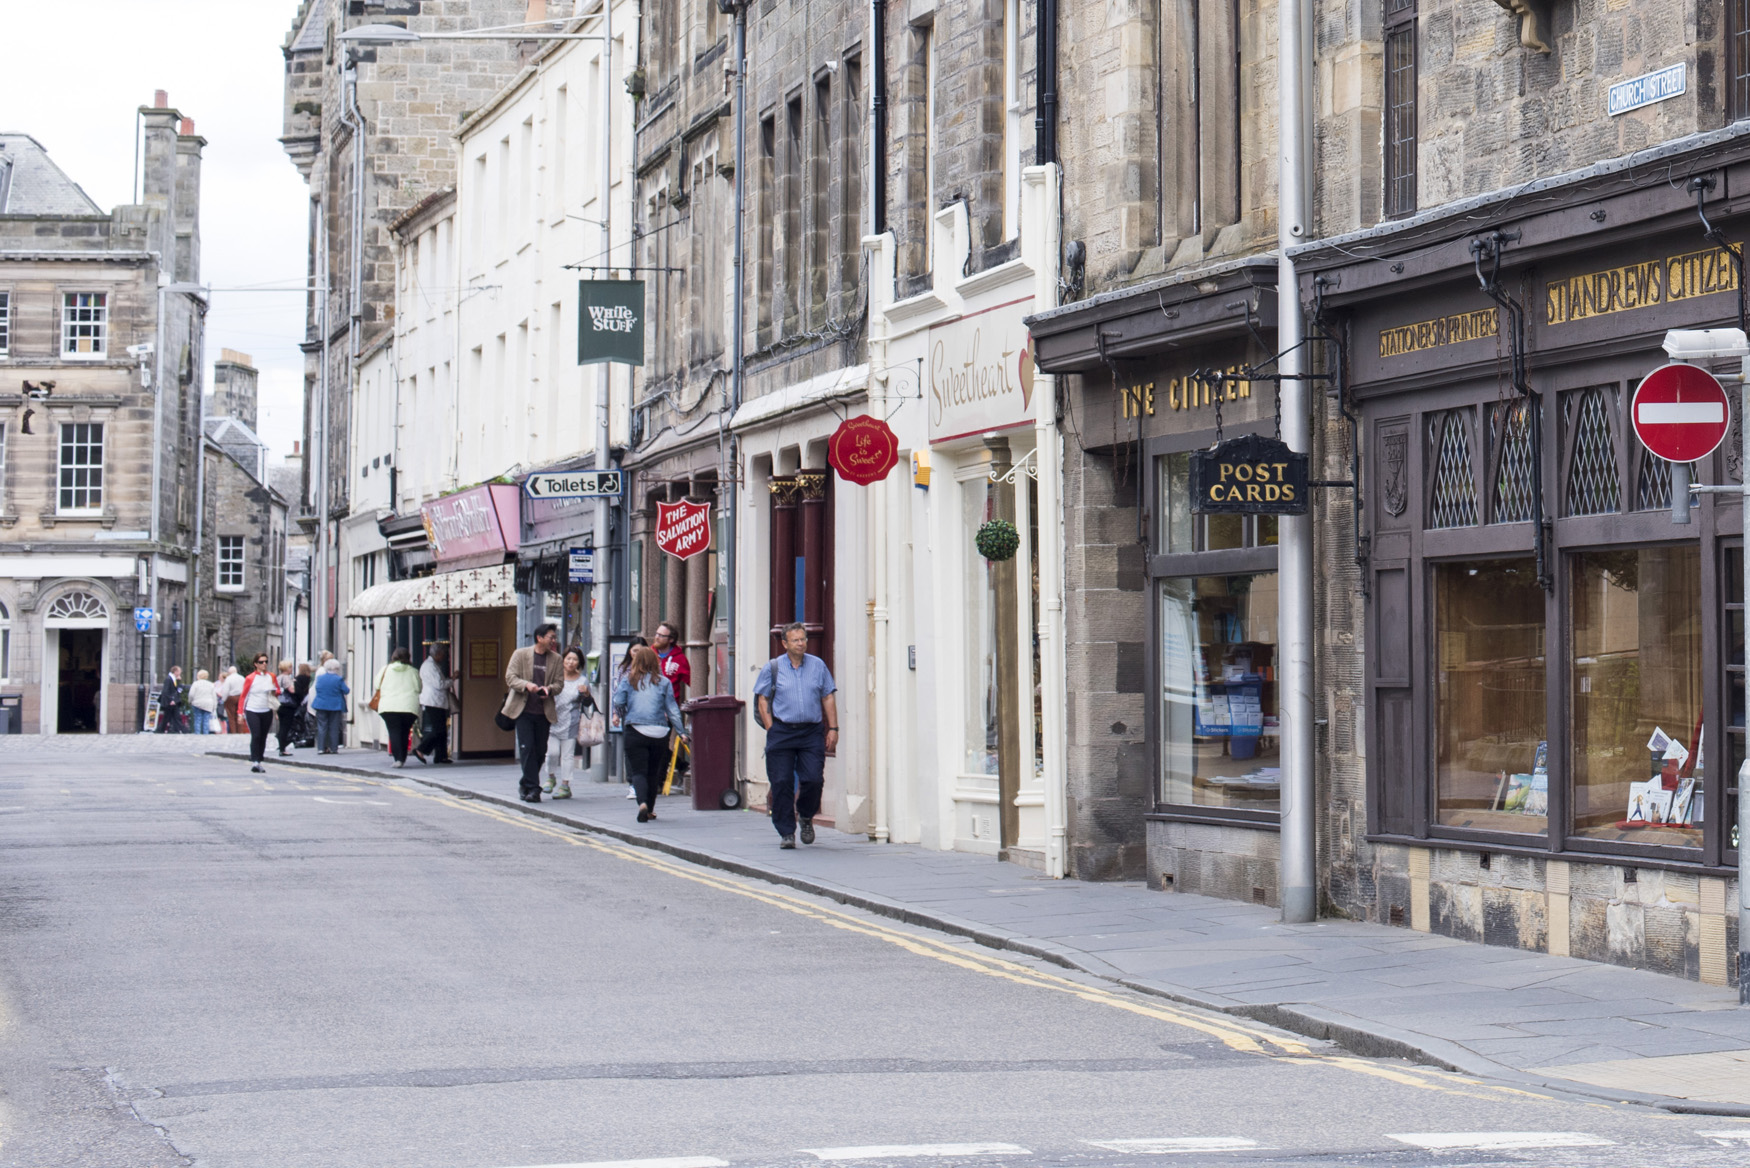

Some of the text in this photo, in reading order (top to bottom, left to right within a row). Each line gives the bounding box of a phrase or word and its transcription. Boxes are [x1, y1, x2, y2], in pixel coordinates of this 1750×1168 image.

[1610, 67, 1684, 111] CHURCH STREET
[1547, 282, 1566, 323] ST
[1571, 260, 1660, 318] ANDREWS
[1380, 321, 1437, 357] STATIONERS
[1448, 310, 1499, 344] PRINTERS
[932, 327, 1014, 427] Sweetheart
[1120, 382, 1155, 419] THE
[855, 434, 872, 448] Life
[849, 453, 876, 466] Sweet
[1219, 463, 1288, 482] POST
[545, 478, 596, 493] Toilets
[1209, 484, 1295, 502] CARDS
[658, 508, 705, 545] SALVATION
[665, 505, 687, 525] THE
[675, 525, 704, 553] ARMY
